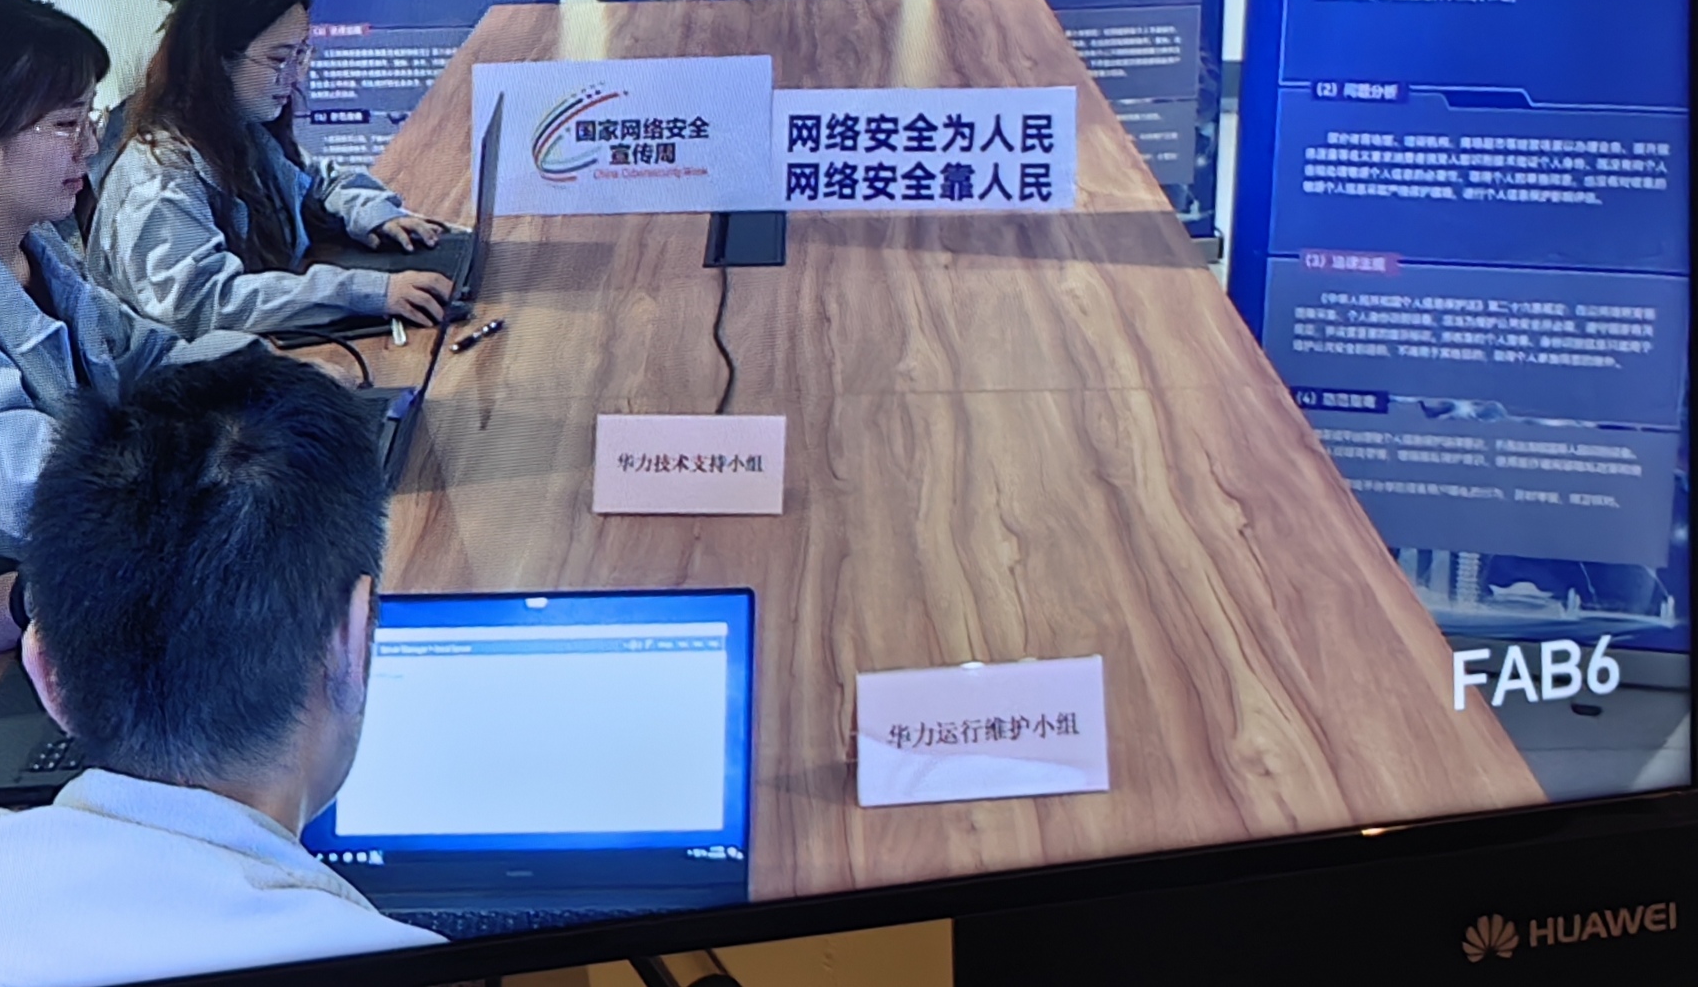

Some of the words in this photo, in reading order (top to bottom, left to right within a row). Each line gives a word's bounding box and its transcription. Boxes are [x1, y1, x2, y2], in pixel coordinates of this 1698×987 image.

[575, 116, 710, 142] 国家网络安全
[787, 113, 1054, 153] 网络安全为人民
[609, 142, 677, 165] 宣传周
[785, 161, 1053, 202] 网络安全靠人民
[617, 452, 764, 474] 华力技术支持小组
[1452, 634, 1620, 711] FAB6
[887, 711, 1080, 749] 华力运行维护小组
[1528, 901, 1677, 948] HUAWEI
